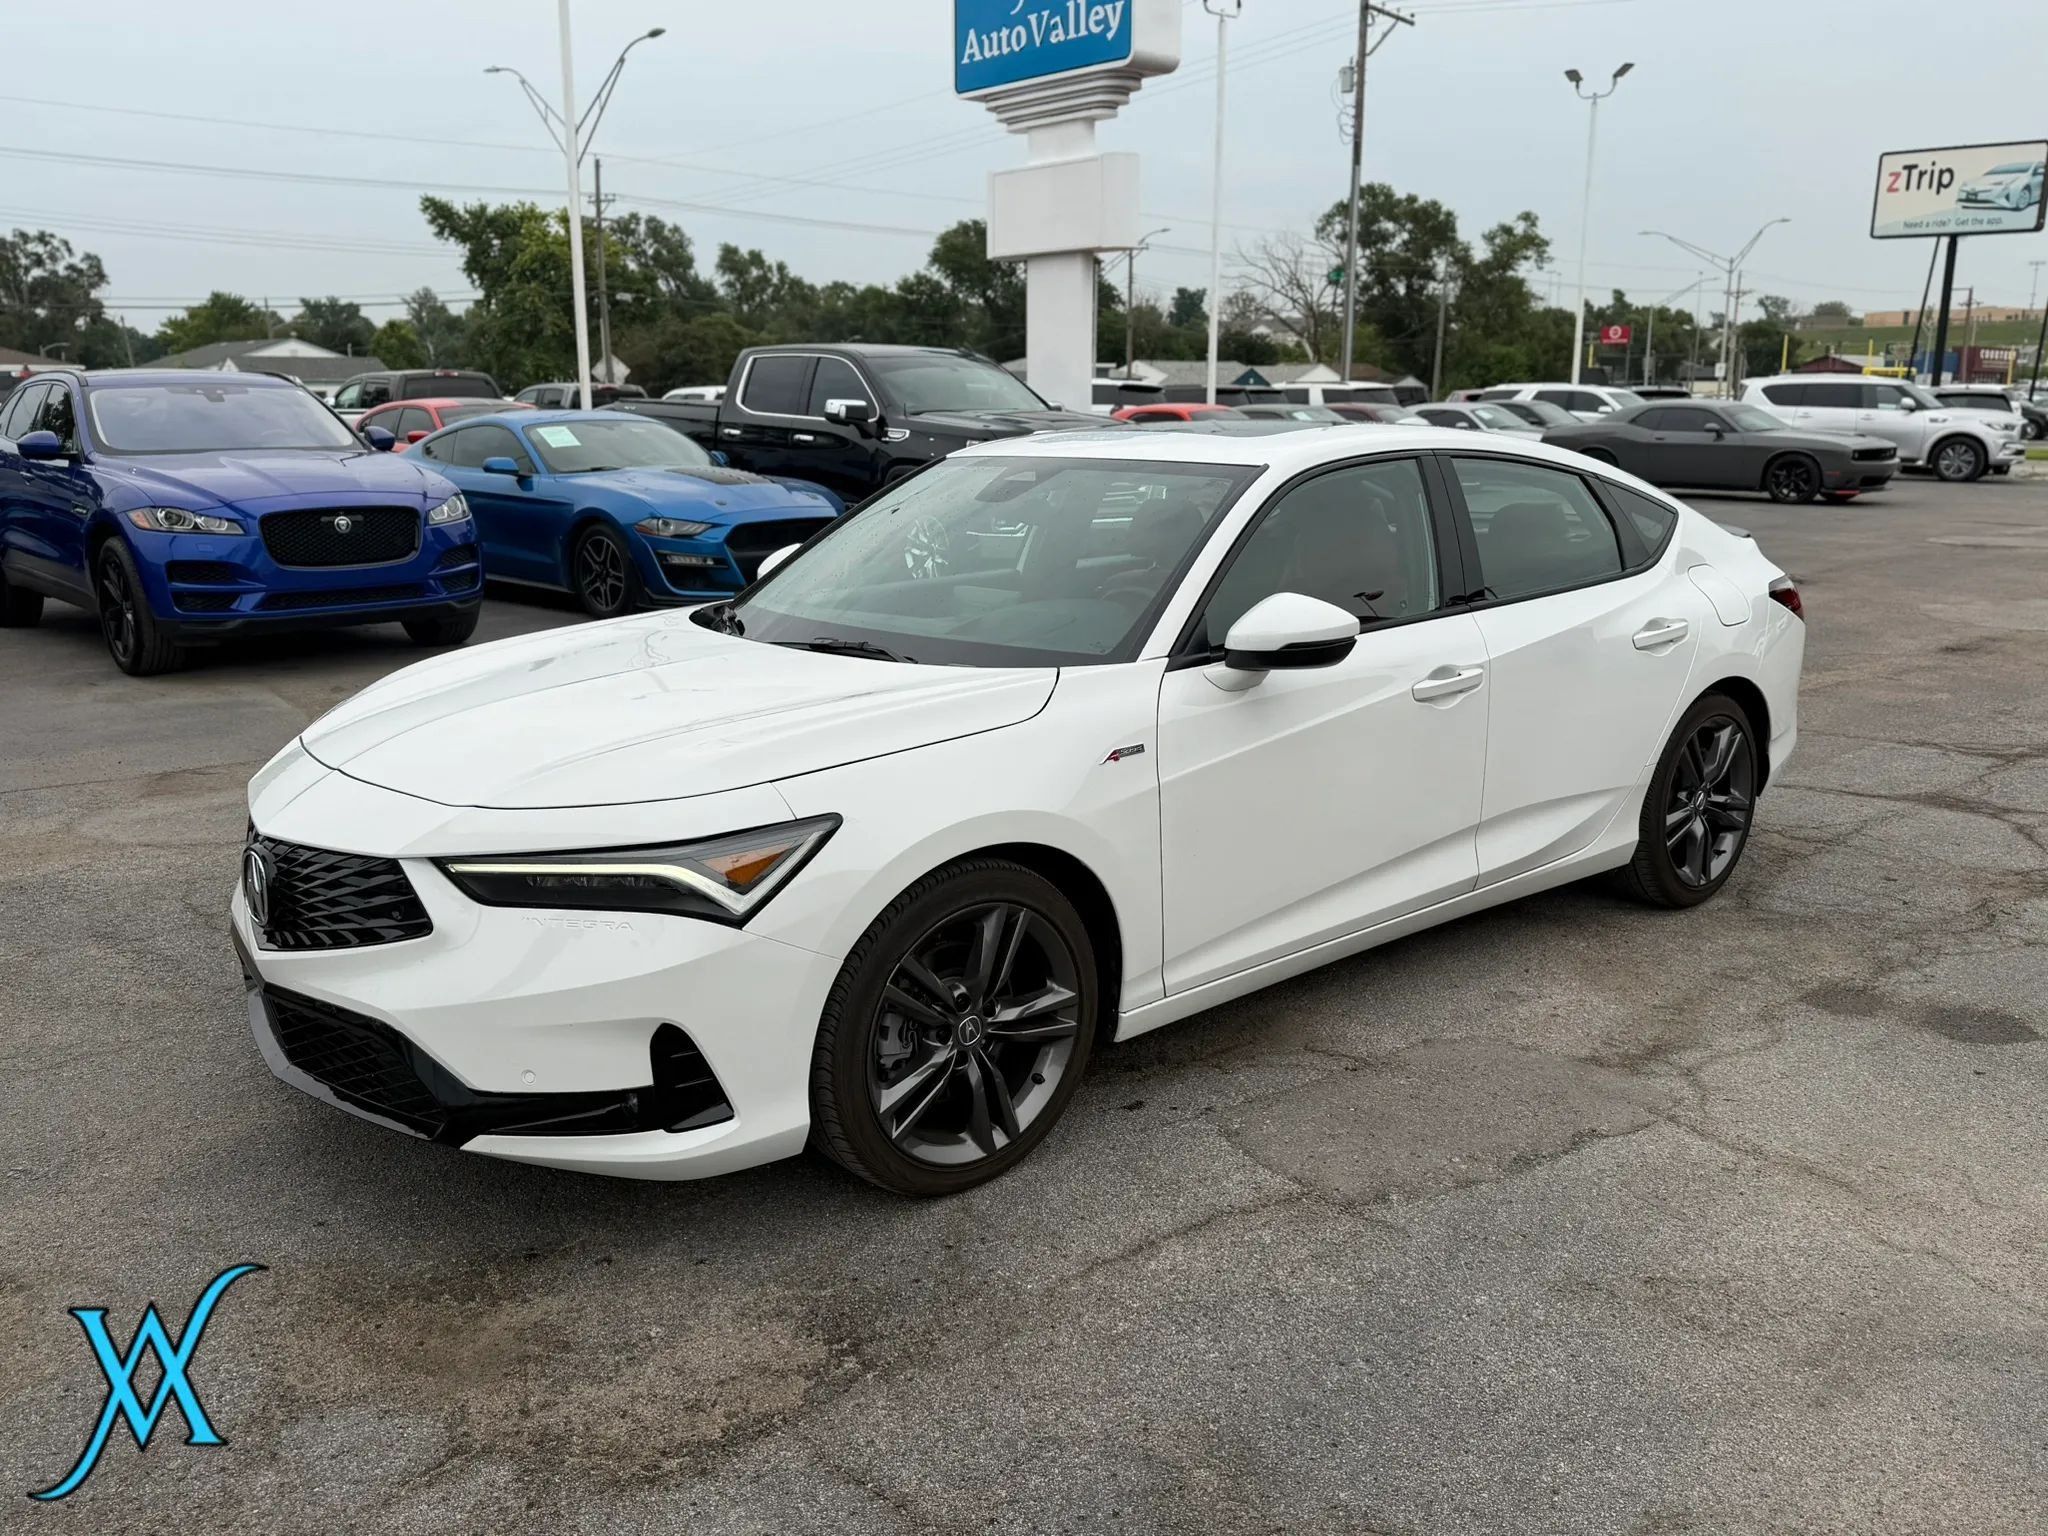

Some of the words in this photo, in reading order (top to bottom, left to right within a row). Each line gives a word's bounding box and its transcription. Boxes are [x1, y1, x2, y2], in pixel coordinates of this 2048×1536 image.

[1886, 160, 1956, 196] zTrip
[1903, 219, 1923, 229] Need
[1954, 217, 1969, 227] Get
[1971, 216, 1985, 226] the
[521, 914, 634, 932] INTEGRA
